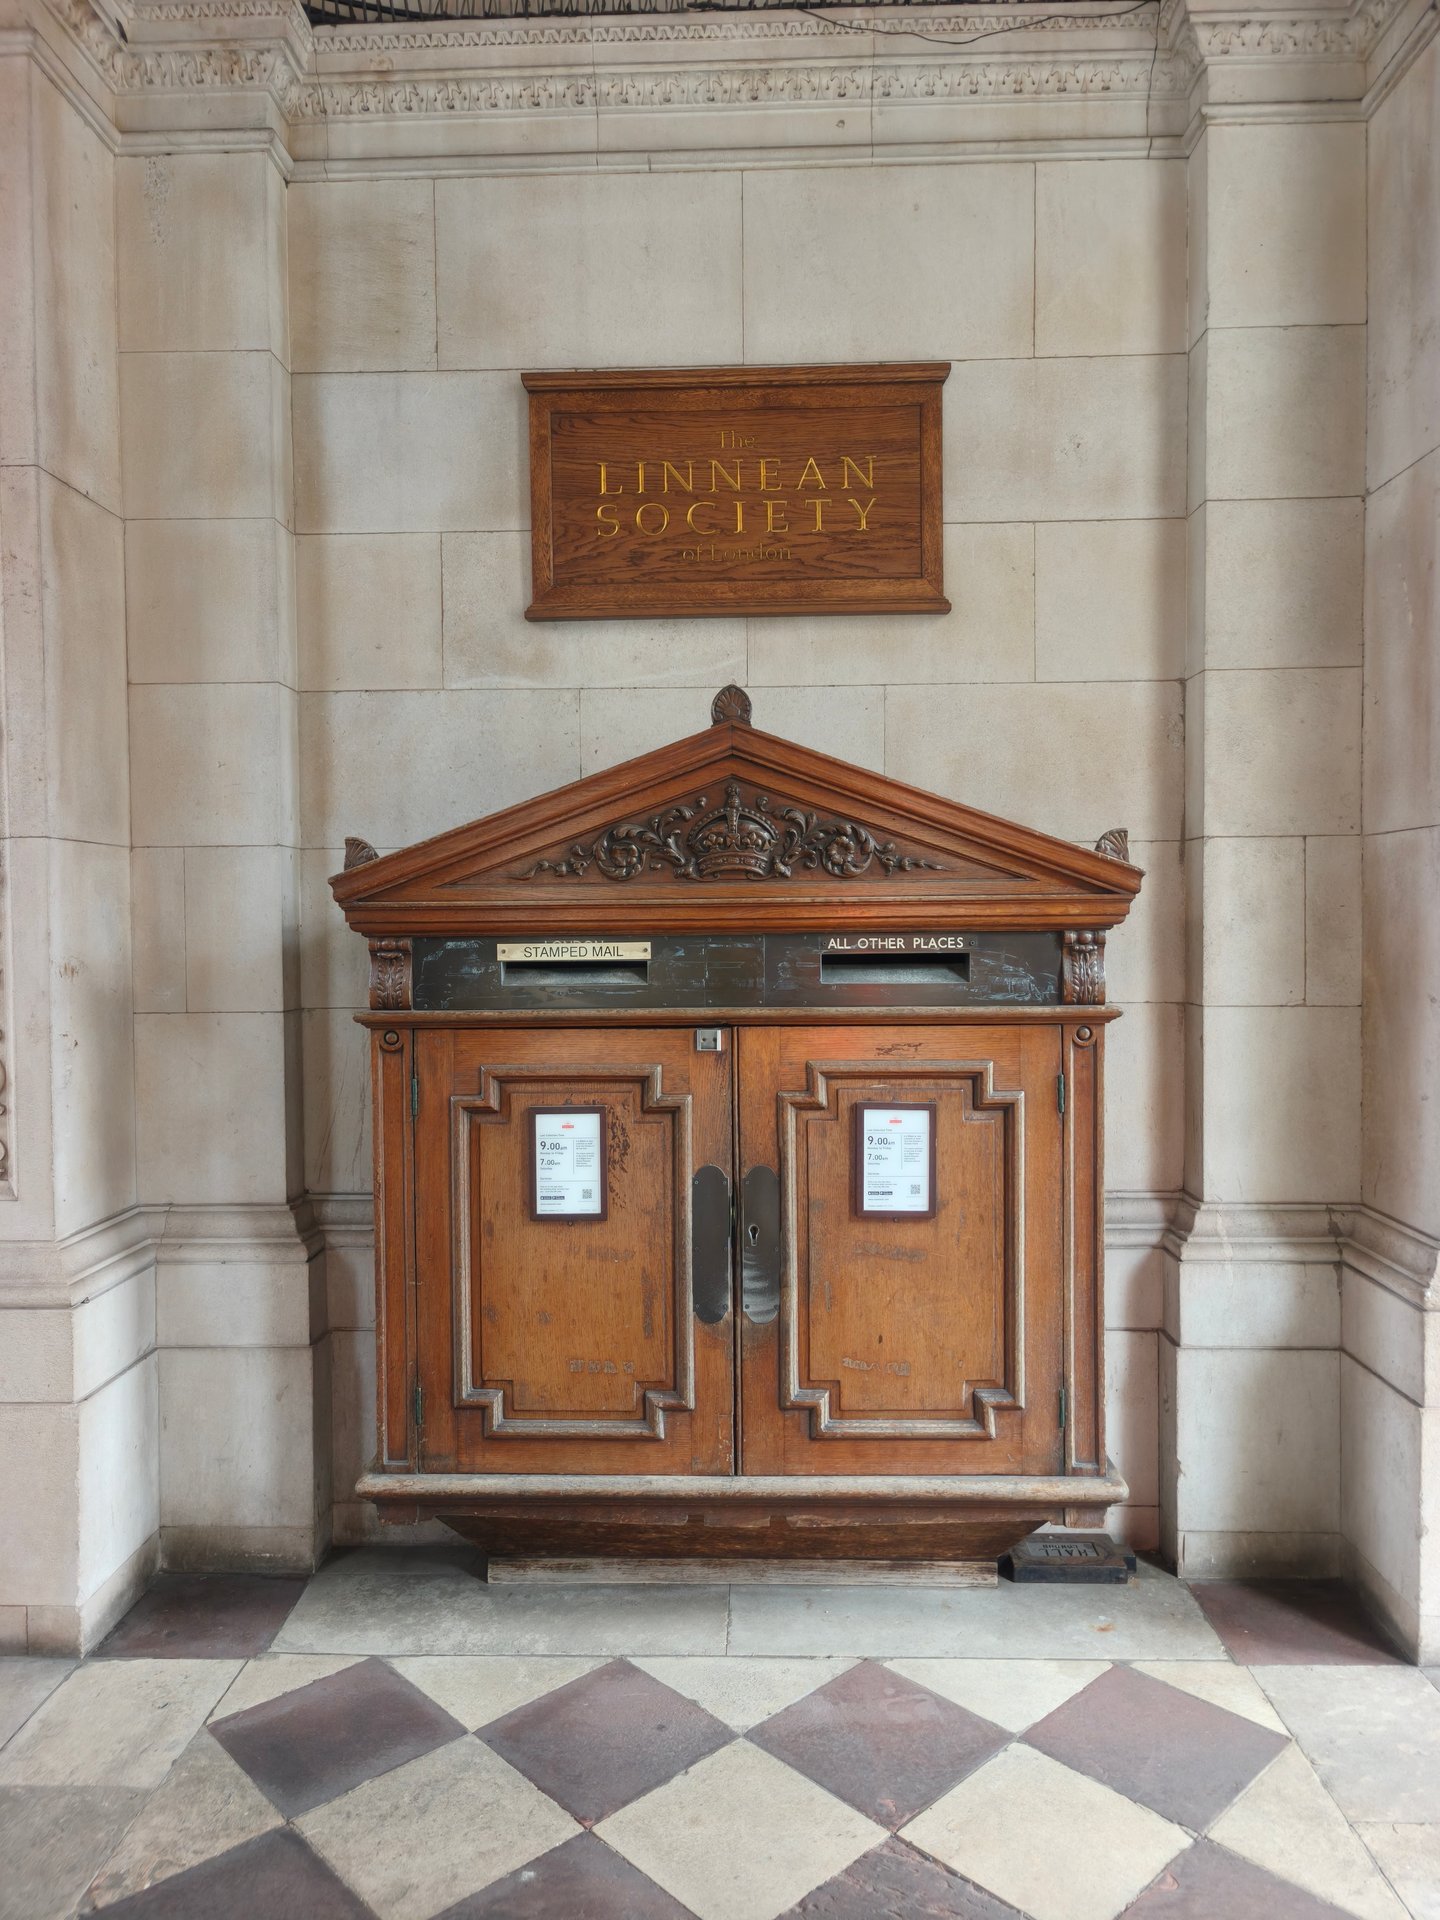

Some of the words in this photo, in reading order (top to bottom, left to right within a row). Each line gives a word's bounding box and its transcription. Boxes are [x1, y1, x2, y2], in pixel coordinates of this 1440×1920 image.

[719, 430, 756, 449] The
[597, 455, 877, 495] LINNEAN
[597, 497, 877, 537] SOCIETY
[682, 544, 704, 562] of
[708, 542, 792, 562] London
[523, 946, 588, 958] STAMPED
[592, 945, 624, 957] MAIL
[828, 938, 851, 950] ALL
[857, 938, 905, 949] OTHER
[913, 937, 964, 949] PLACES
